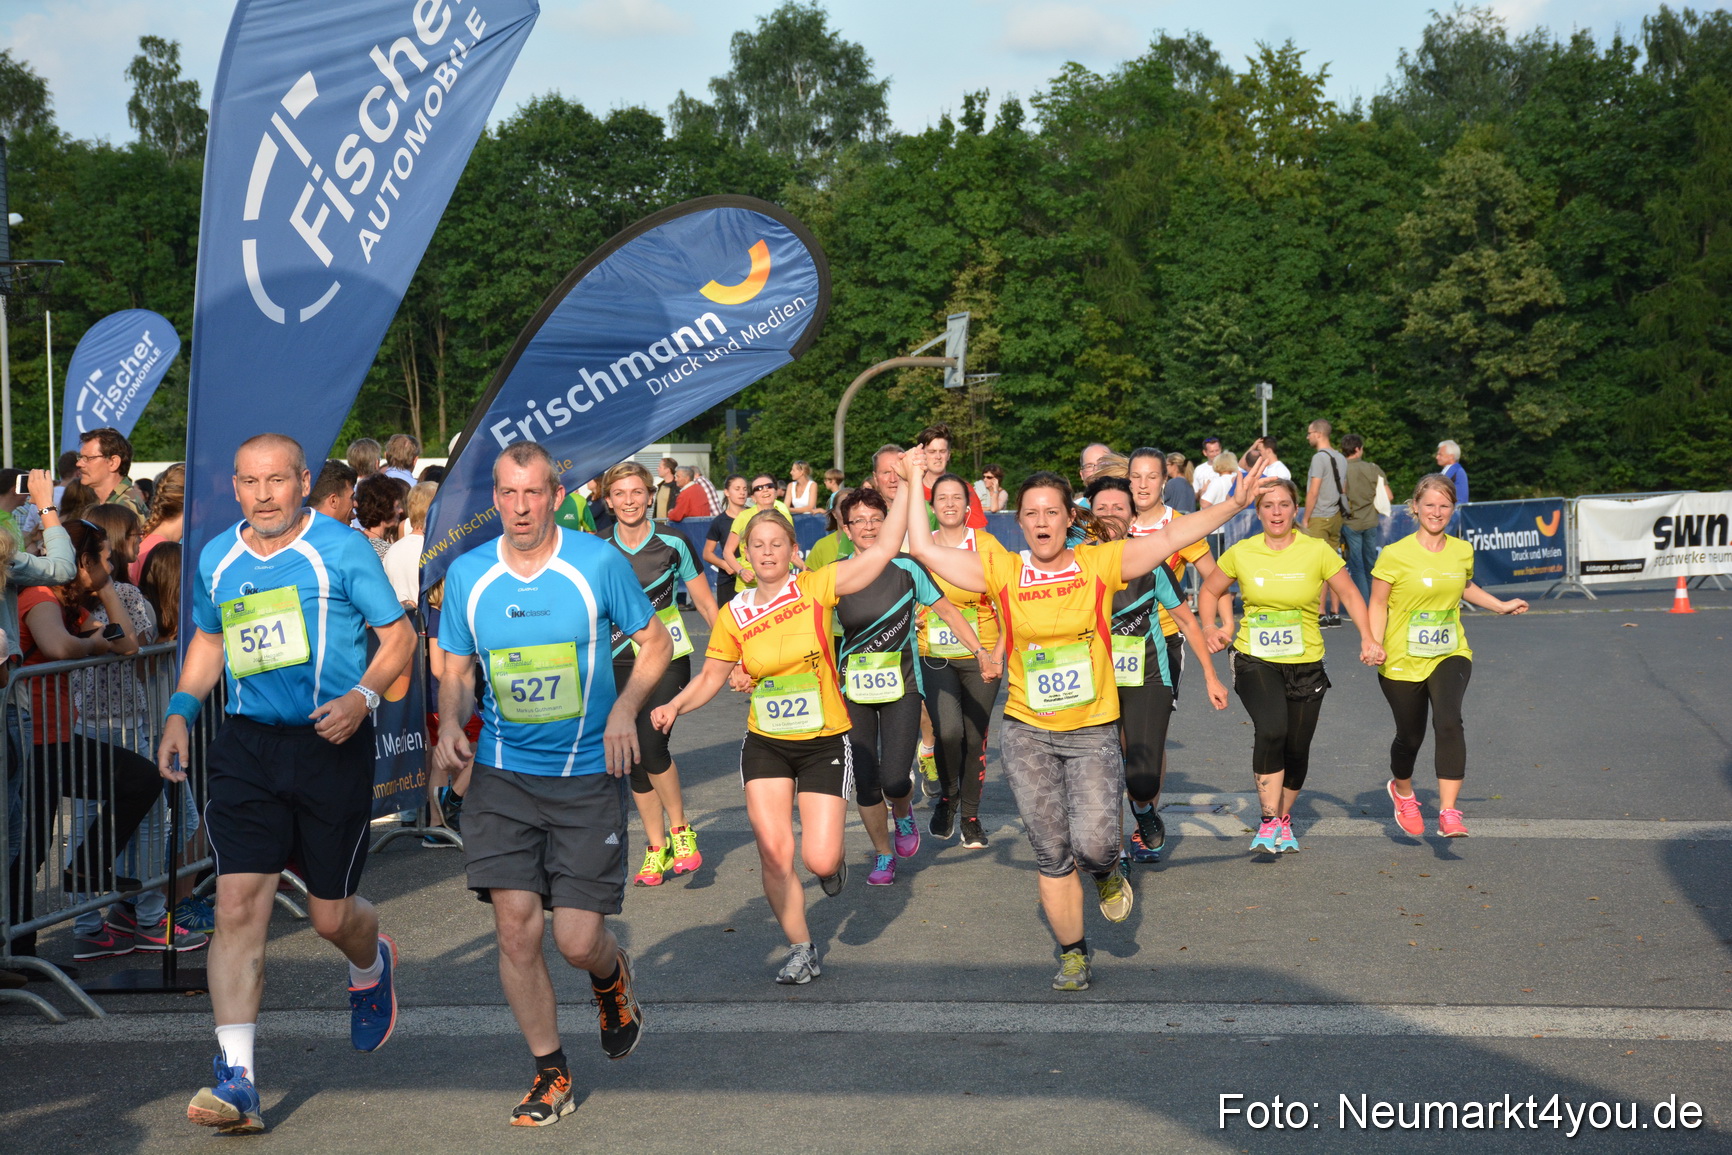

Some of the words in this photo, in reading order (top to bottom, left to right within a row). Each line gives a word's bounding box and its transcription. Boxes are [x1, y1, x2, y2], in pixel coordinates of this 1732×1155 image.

[288, 0, 462, 268] Fische
[357, 6, 487, 264] AUTOMOBILE
[645, 355, 703, 396] Druck
[703, 335, 742, 364] und
[740, 295, 808, 346] Medien
[91, 330, 154, 423] Fischer
[114, 347, 162, 421] AUTOMOBILE
[489, 311, 728, 449] Frischmann
[418, 504, 500, 569] www.frischm
[1466, 527, 1540, 551] Frischmann
[1511, 549, 1529, 561] Druck
[1529, 548, 1541, 560] und
[1708, 551, 1732, 564] neum
[651, 583, 674, 607] onauer
[1018, 588, 1053, 602] MAX
[1056, 577, 1088, 598] BÖGL
[525, 609, 551, 617] classic
[742, 620, 772, 642] MAX
[774, 601, 811, 625] BÖGL
[240, 620, 286, 653] 521
[670, 626, 682, 642] 9
[873, 639, 883, 648] &
[881, 611, 910, 642] Donauer
[938, 630, 959, 646] 88
[1258, 630, 1294, 646] 645
[1418, 628, 1450, 645] 646
[1114, 656, 1139, 672] 48
[510, 675, 561, 703] 527
[852, 671, 898, 689] 1363
[1037, 669, 1081, 694] 882
[766, 697, 810, 719] 922
[382, 728, 423, 757] Medien
